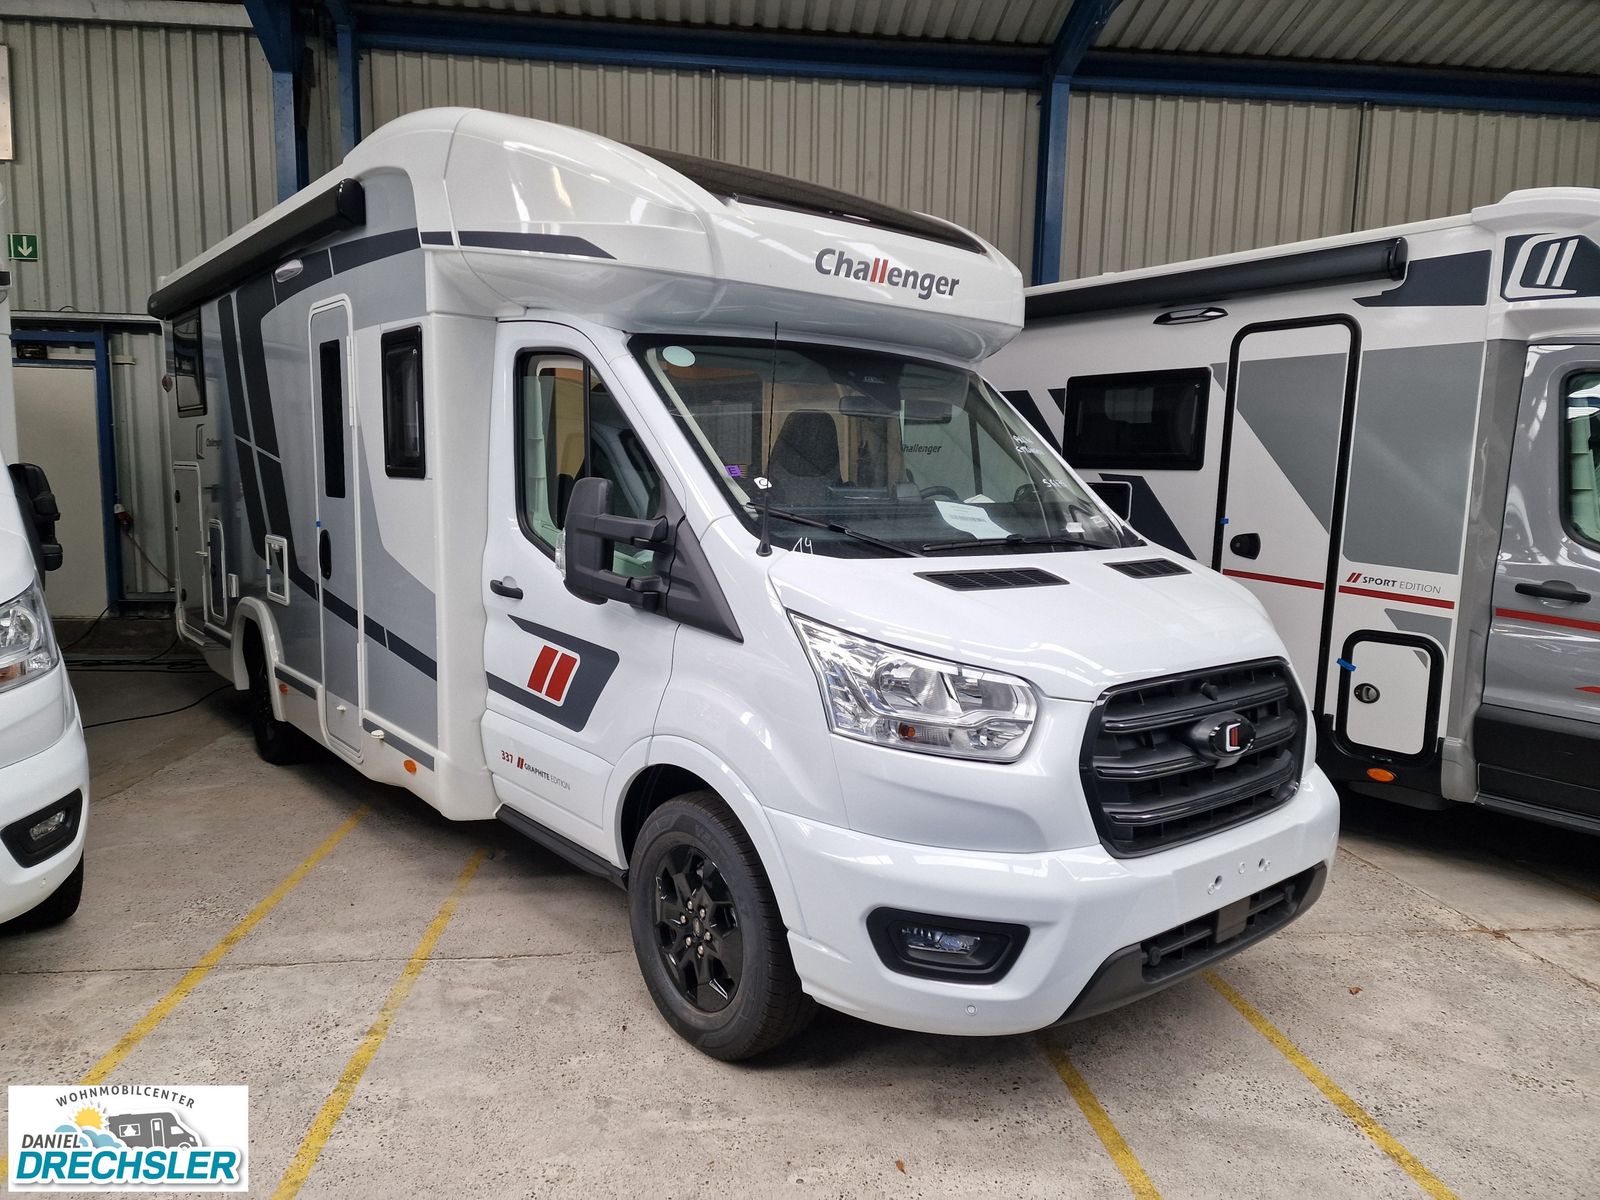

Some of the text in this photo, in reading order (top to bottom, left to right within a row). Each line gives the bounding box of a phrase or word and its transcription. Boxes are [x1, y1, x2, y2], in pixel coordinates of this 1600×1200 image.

[815, 248, 960, 300] Challenger
[901, 443, 942, 455] hallenger
[1362, 576, 1441, 594] SPORT EDITION
[501, 750, 570, 790] 337 GRAPHITE EDITION
